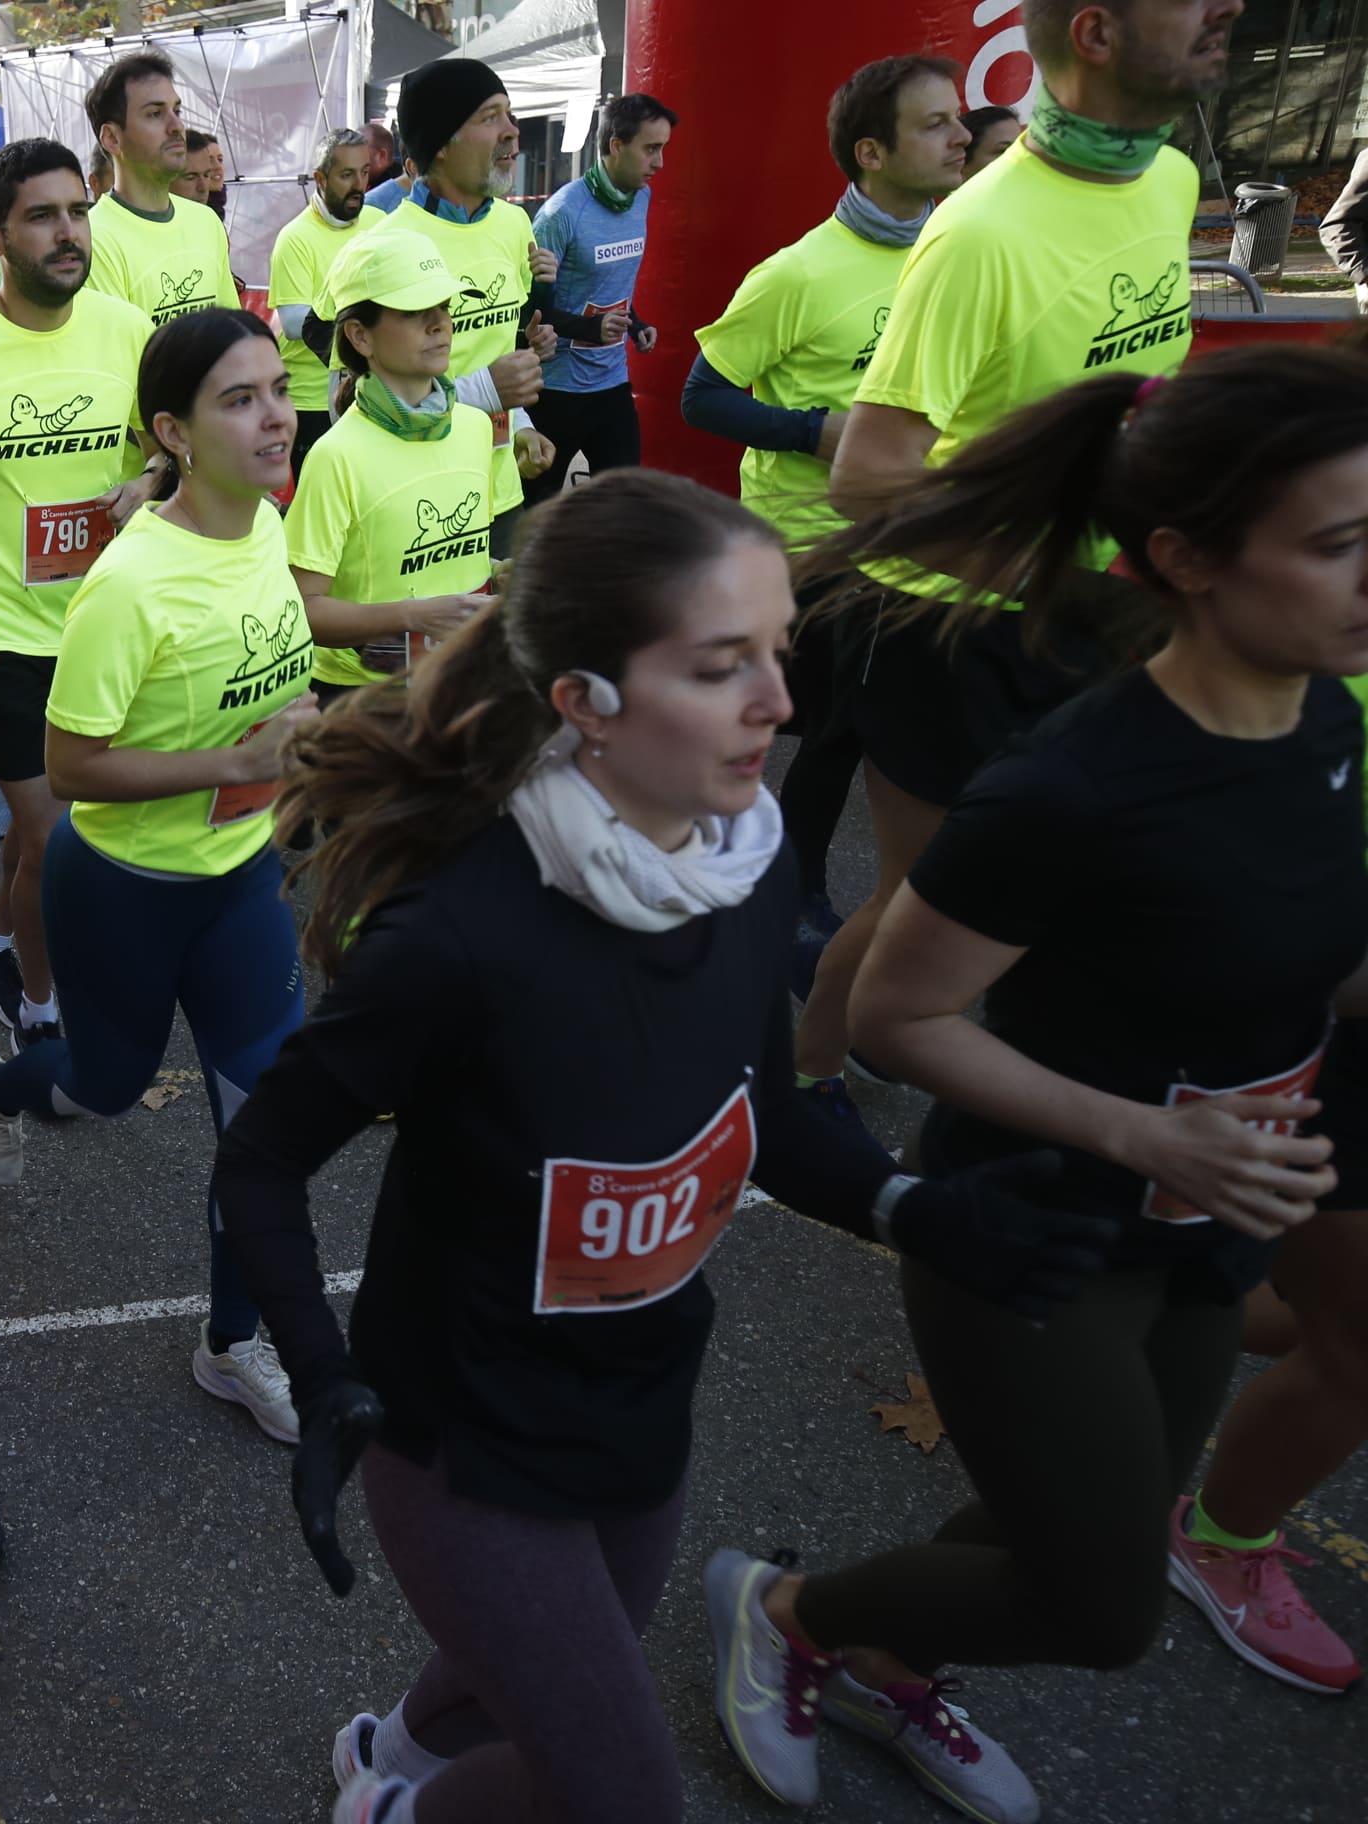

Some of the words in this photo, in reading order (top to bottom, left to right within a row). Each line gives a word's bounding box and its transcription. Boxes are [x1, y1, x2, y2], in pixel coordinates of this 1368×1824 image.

[597, 241, 643, 260] socamex
[40, 516, 89, 555] 796
[579, 1173, 701, 1260] 902
